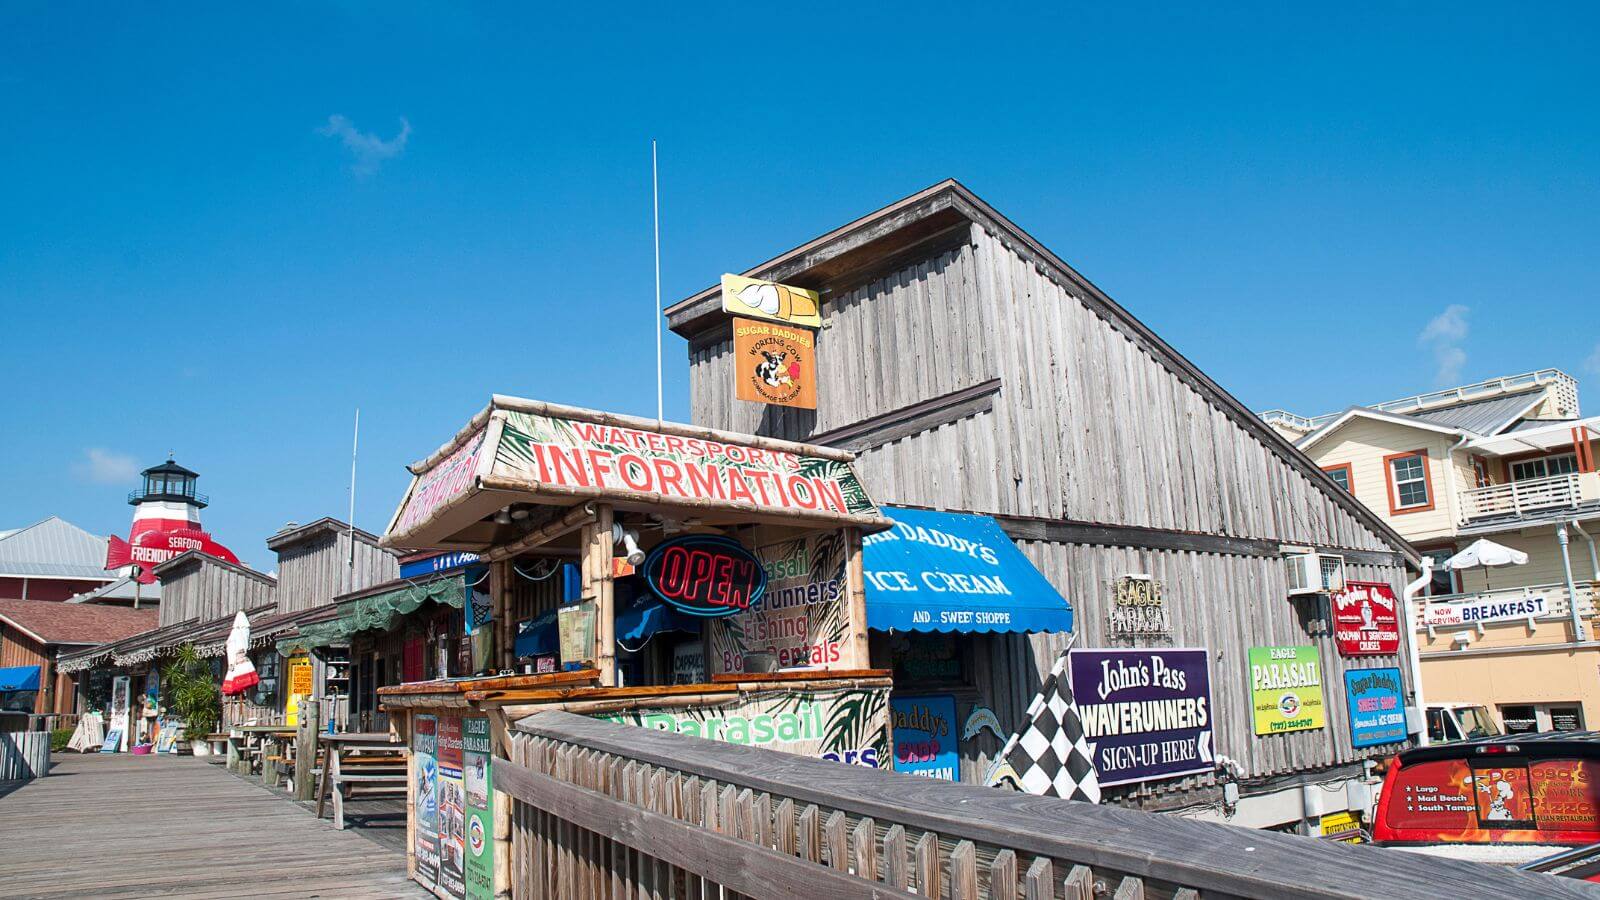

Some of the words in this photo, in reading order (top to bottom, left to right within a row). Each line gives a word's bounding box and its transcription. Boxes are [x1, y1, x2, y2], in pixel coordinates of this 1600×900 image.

[736, 326, 770, 338] SUGAR
[771, 328, 811, 348] DADDIES
[748, 337, 785, 357] WORKING
[786, 344, 803, 363] COW
[751, 376, 778, 403] HOMEMADE
[778, 395, 788, 403] ICE
[788, 385, 802, 401] CREAM
[573, 422, 803, 470] WATERSPORTS
[532, 443, 848, 515] INFORMATION
[168, 536, 203, 550] SEAFOOD
[898, 521, 1000, 567] DADDY'S
[659, 545, 755, 609] OPEN
[765, 549, 810, 581] asail
[863, 569, 918, 592] ICE
[921, 570, 1012, 596] CREAM
[1116, 579, 1163, 607] EAGLE
[1335, 585, 1369, 611] Dolphin
[1462, 598, 1544, 621] BREAKFAST
[912, 611, 931, 624] AND
[940, 611, 973, 624] SWEET
[975, 611, 1011, 624] SHOPPE
[1109, 606, 1174, 633] PARASAIL
[1434, 607, 1452, 616] NOW
[743, 615, 809, 642] Fishing
[1338, 631, 1362, 641] DOLPHIN
[1270, 647, 1297, 660] EAGLE
[1097, 658, 1149, 701] John's
[1150, 655, 1187, 692] Pass
[1252, 662, 1320, 690] PARASAIL
[467, 720, 487, 735] EAGLE
[646, 702, 826, 745] Parasail
[1079, 696, 1207, 738] WAVERUNNERS
[463, 736, 491, 753] PARASAIL
[897, 740, 941, 763] SHOP
[1102, 742, 1159, 772] SIGN-UP
[1161, 737, 1197, 764] HERE
[1418, 804, 1444, 812] South
[1439, 794, 1468, 802] Beach
[1556, 815, 1597, 823] RESTAURANT
